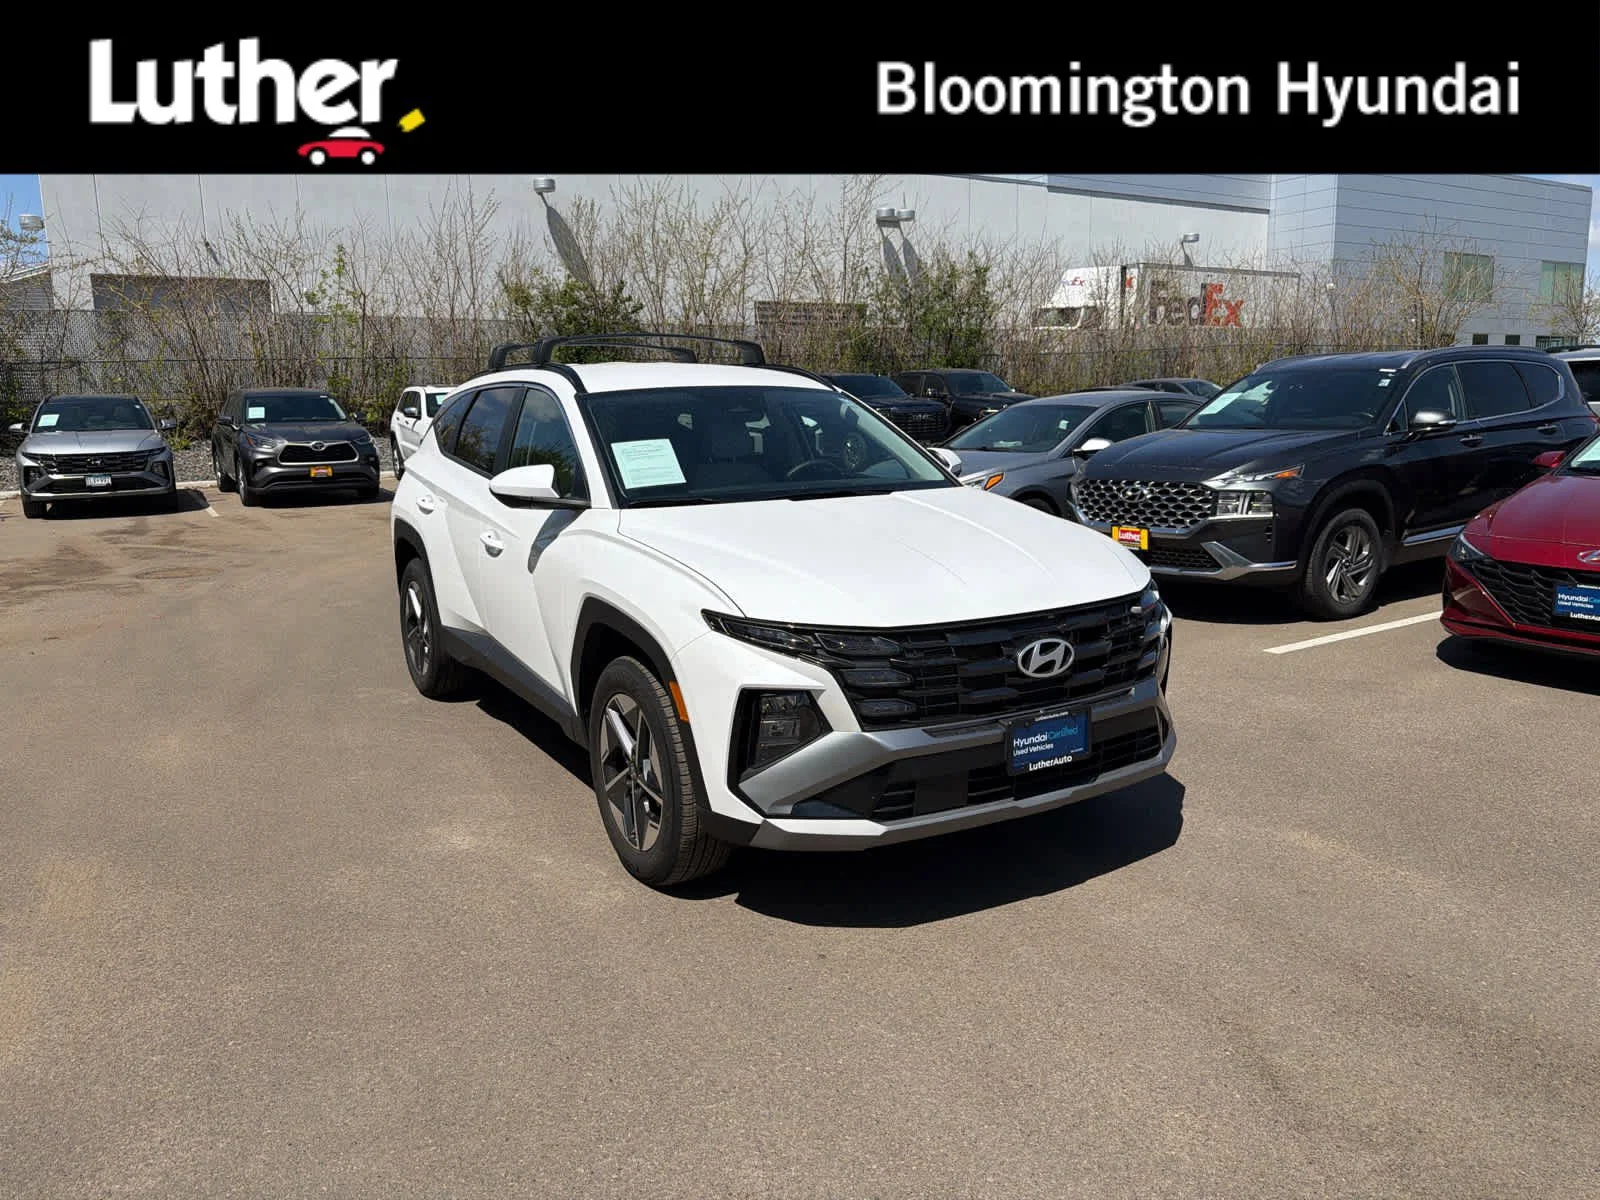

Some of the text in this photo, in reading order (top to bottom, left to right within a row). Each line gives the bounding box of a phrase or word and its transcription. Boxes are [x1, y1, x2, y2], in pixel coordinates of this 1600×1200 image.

[1149, 279, 1244, 327] FedEx
[1013, 743, 1054, 757] Used Vehicles
[1029, 755, 1073, 771] LutherAuto
